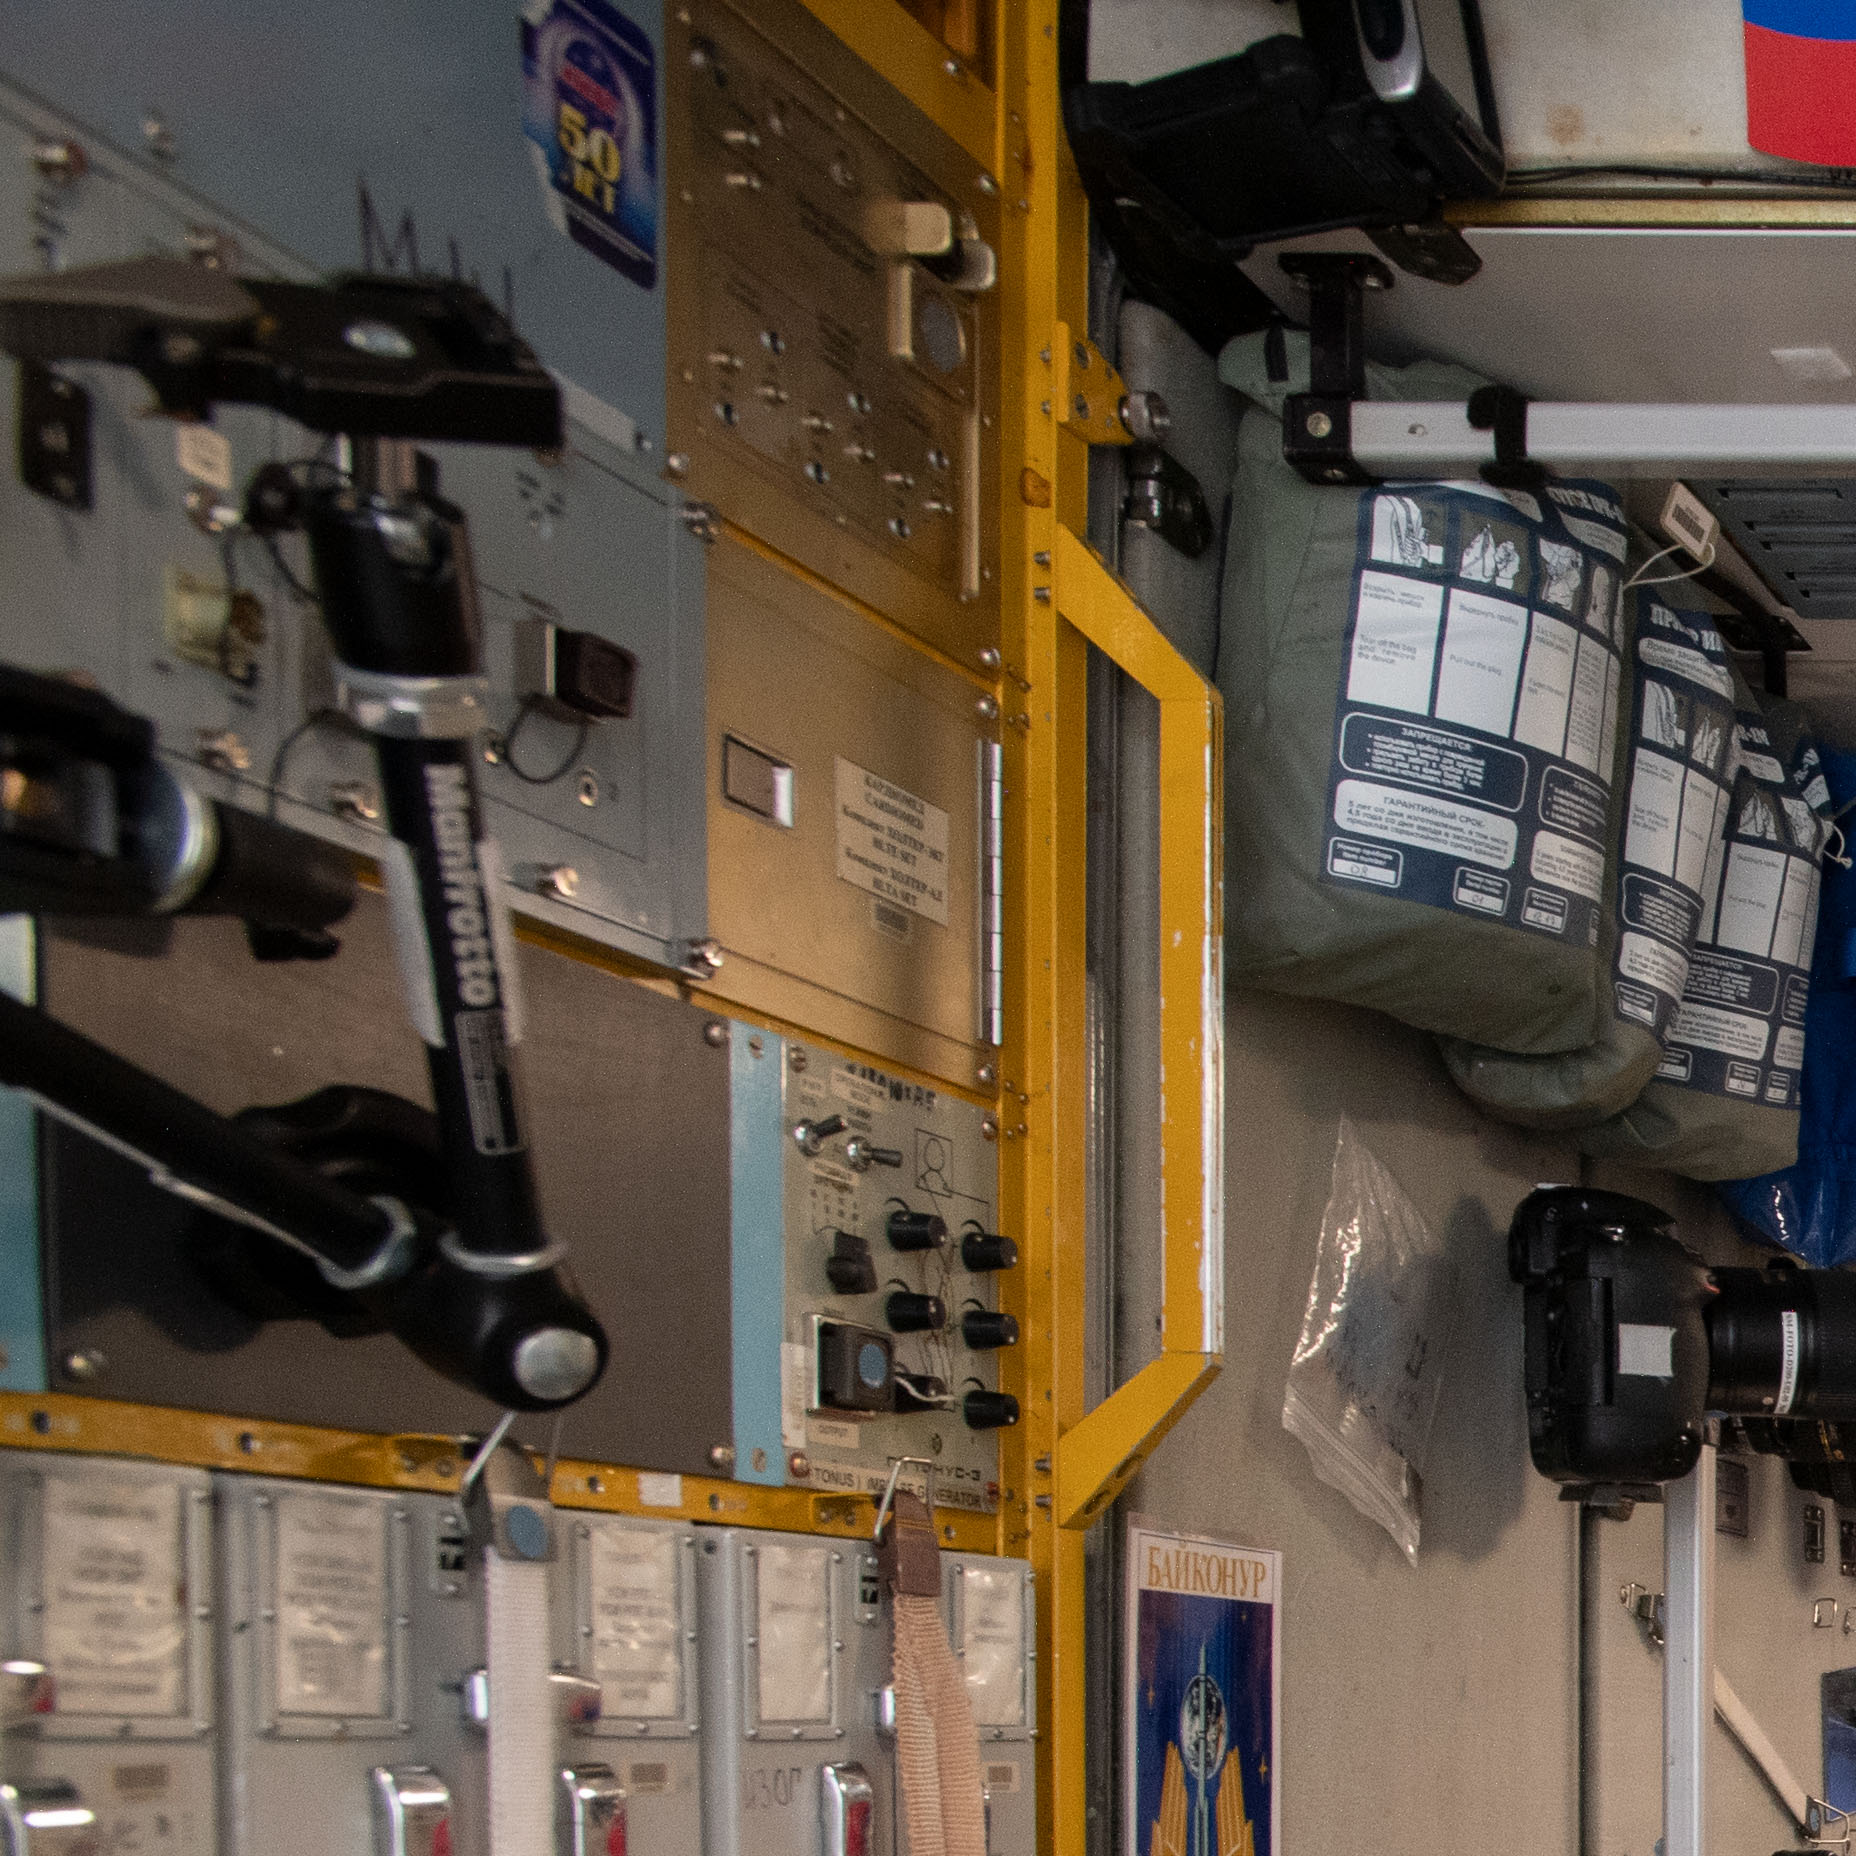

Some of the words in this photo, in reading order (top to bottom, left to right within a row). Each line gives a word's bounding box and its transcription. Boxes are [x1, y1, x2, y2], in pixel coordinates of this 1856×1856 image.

[558, 102, 621, 182] 50
[424, 763, 498, 1008] Manfrotto
[814, 1466, 855, 1488] TONUS
[1148, 1542, 1266, 1598] БАЙКОНУР
